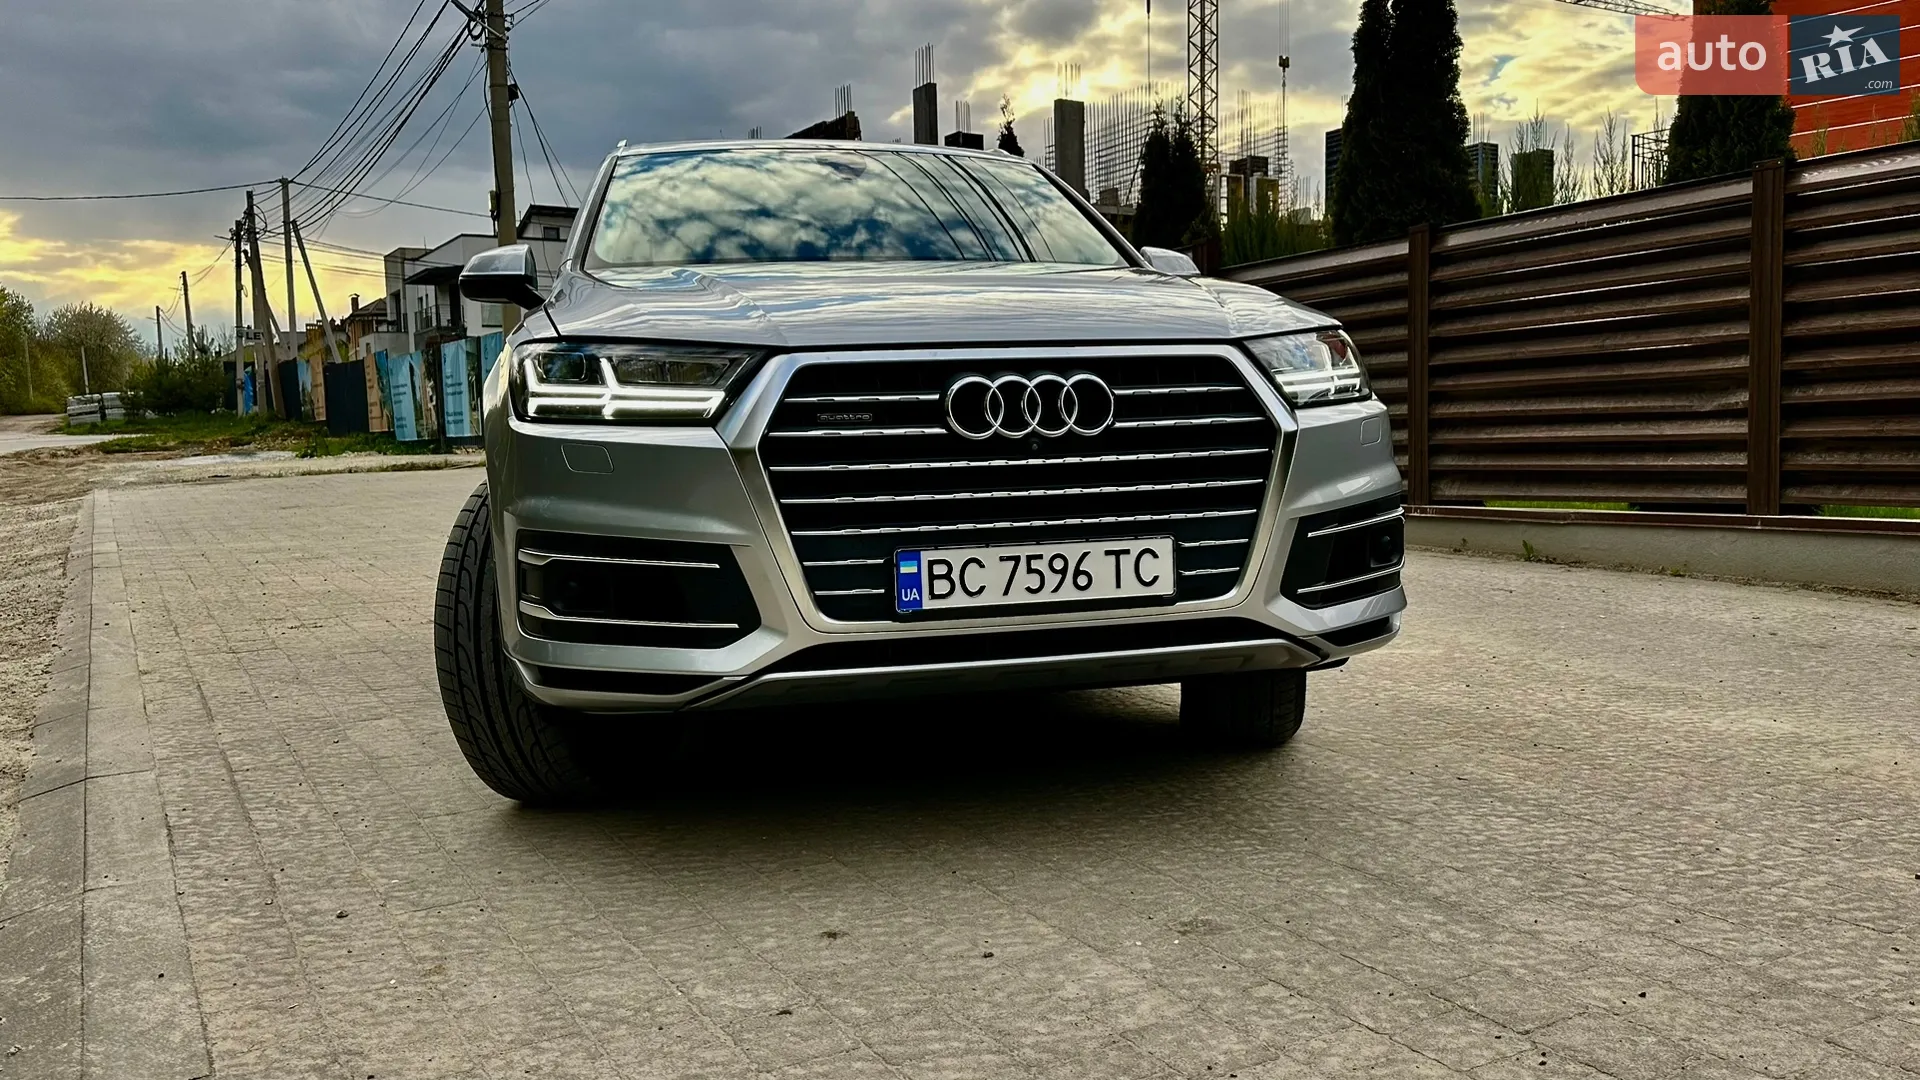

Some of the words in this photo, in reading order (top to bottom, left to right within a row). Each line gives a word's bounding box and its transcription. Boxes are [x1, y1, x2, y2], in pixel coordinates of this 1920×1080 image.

[927, 556, 987, 601] BC
[998, 550, 1094, 597] 7596
[1103, 547, 1160, 589] TC
[901, 588, 920, 602] UA
